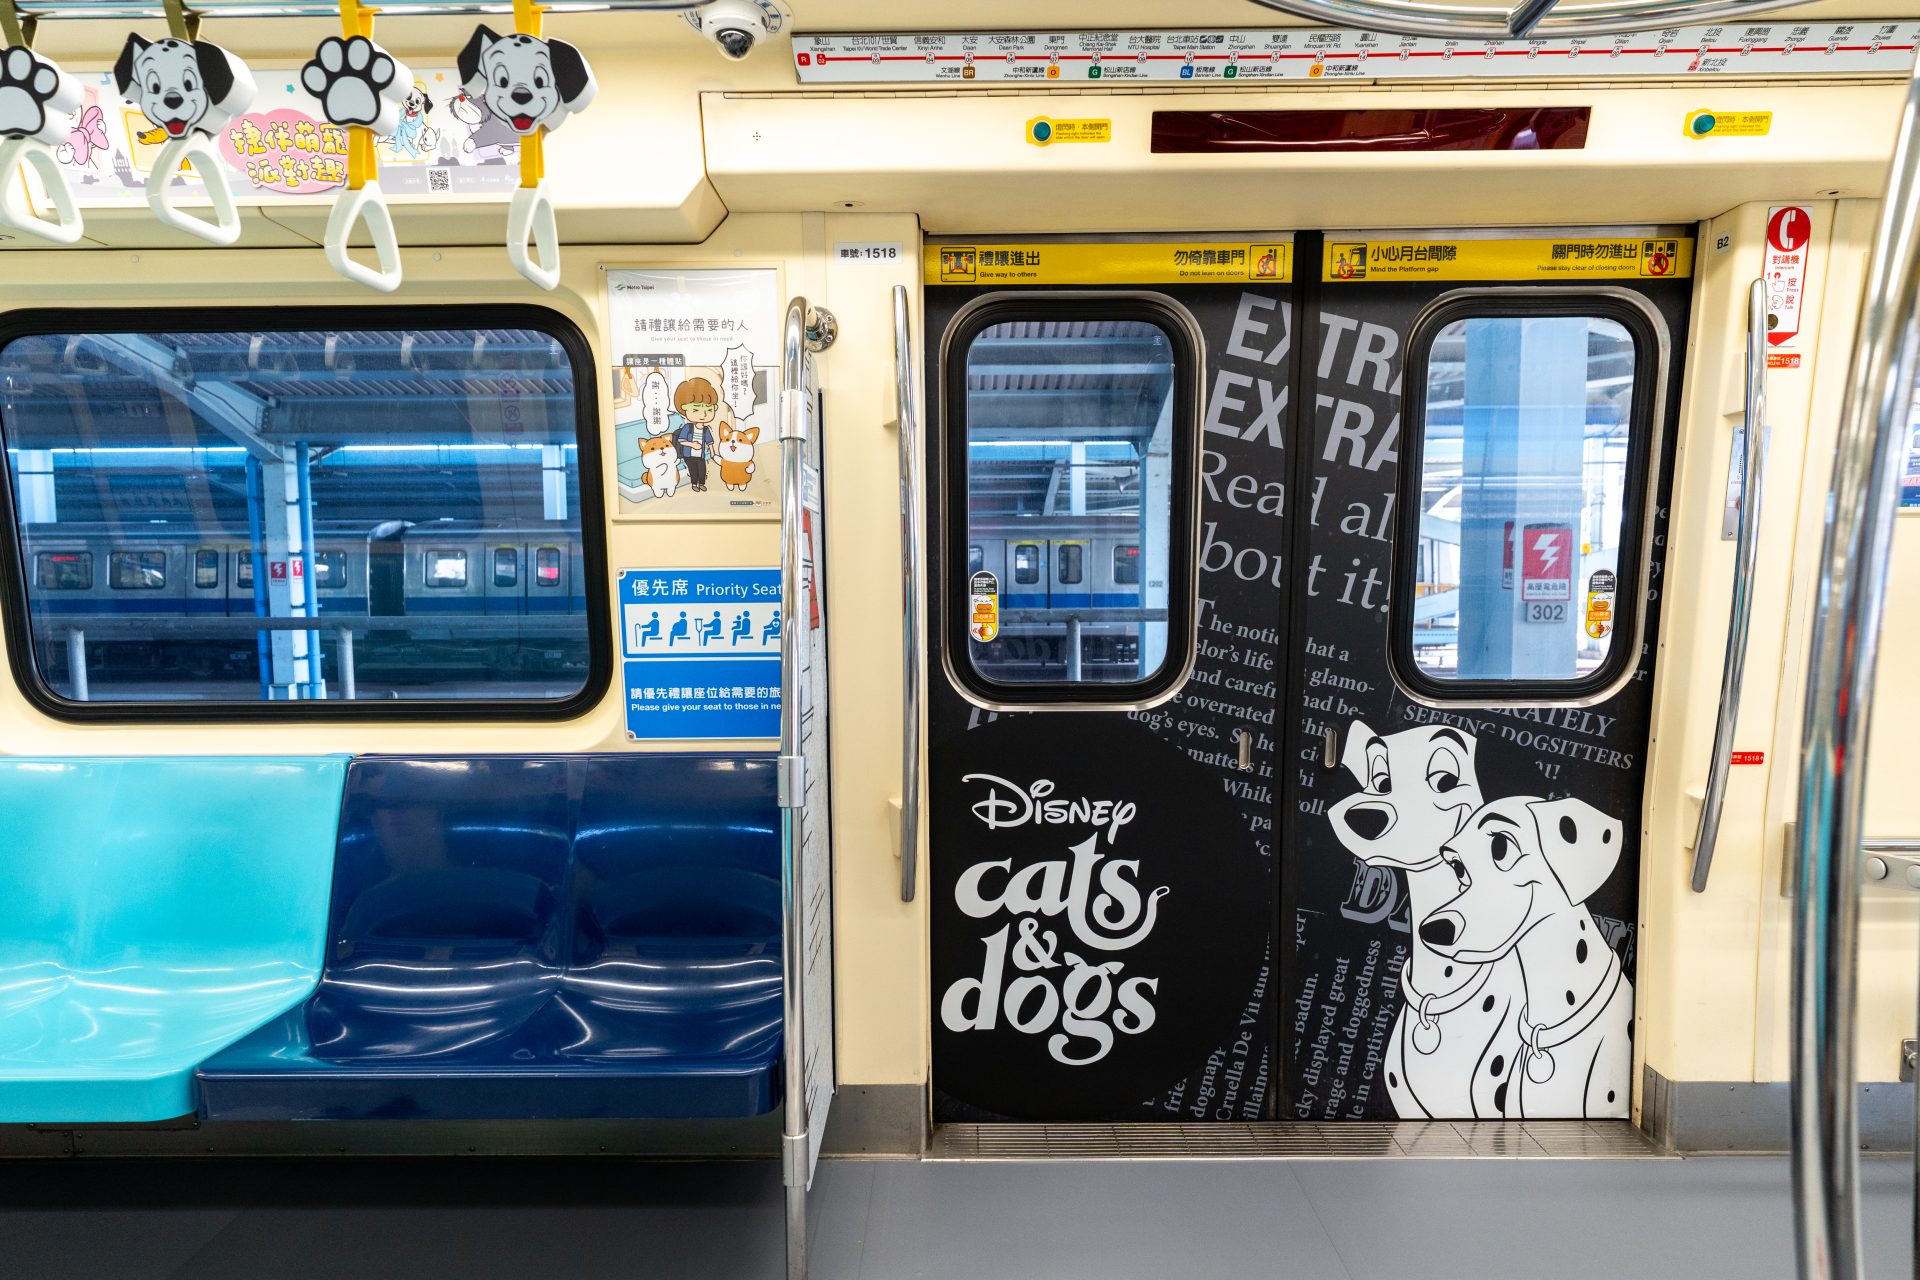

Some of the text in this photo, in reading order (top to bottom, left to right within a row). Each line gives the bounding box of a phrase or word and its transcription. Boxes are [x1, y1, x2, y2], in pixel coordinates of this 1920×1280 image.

[914, 36, 945, 45] 信義安和
[962, 36, 977, 45] 大安
[989, 36, 1035, 45] 大安森林公園
[1049, 36, 1064, 44] 東門
[1078, 33, 1119, 42] 中正紀念堂
[1129, 35, 1162, 44] 台大醫院
[1167, 35, 1198, 44] 台北車站
[1230, 35, 1246, 43] 中山
[1717, 236, 1729, 249] B2
[979, 251, 1040, 266] 禮讓進出
[1174, 250, 1245, 266] 勿倚靠車門
[1371, 244, 1457, 261] 小心月台間隙
[1552, 243, 1638, 260] 關門時勿進出
[1772, 255, 1799, 265] 對講機
[1430, 267, 1439, 275] gap
[1788, 278, 1796, 287] 按
[634, 318, 749, 332] 請禮讓給需要的人
[1781, 357, 1799, 365] 1518
[632, 579, 688, 597] 優先席
[696, 584, 748, 599] Priority
[1532, 604, 1564, 621] 302
[1339, 650, 1350, 662] a
[1243, 649, 1375, 692] life glamo-
[630, 687, 781, 700] 請優先禮讓座位給需要的旅
[631, 703, 660, 711] Please
[662, 704, 680, 712] give
[682, 703, 701, 711] your
[1187, 695, 1276, 725] overrated
[1177, 719, 1219, 740] eyes.
[1501, 726, 1634, 770] DOGSITTERS
[961, 773, 1137, 845] Disney
[954, 831, 1170, 950] cats
[1012, 917, 1063, 971] &
[940, 922, 1159, 1066] dogs
[1239, 1000, 1261, 1026] Vil
[1336, 939, 1381, 1075] and doggedness
[1303, 1004, 1337, 1086] displayed
[1329, 957, 1350, 1003] great
[1352, 944, 1407, 1103] in captivity, all the
[1232, 1030, 1253, 1058] De
